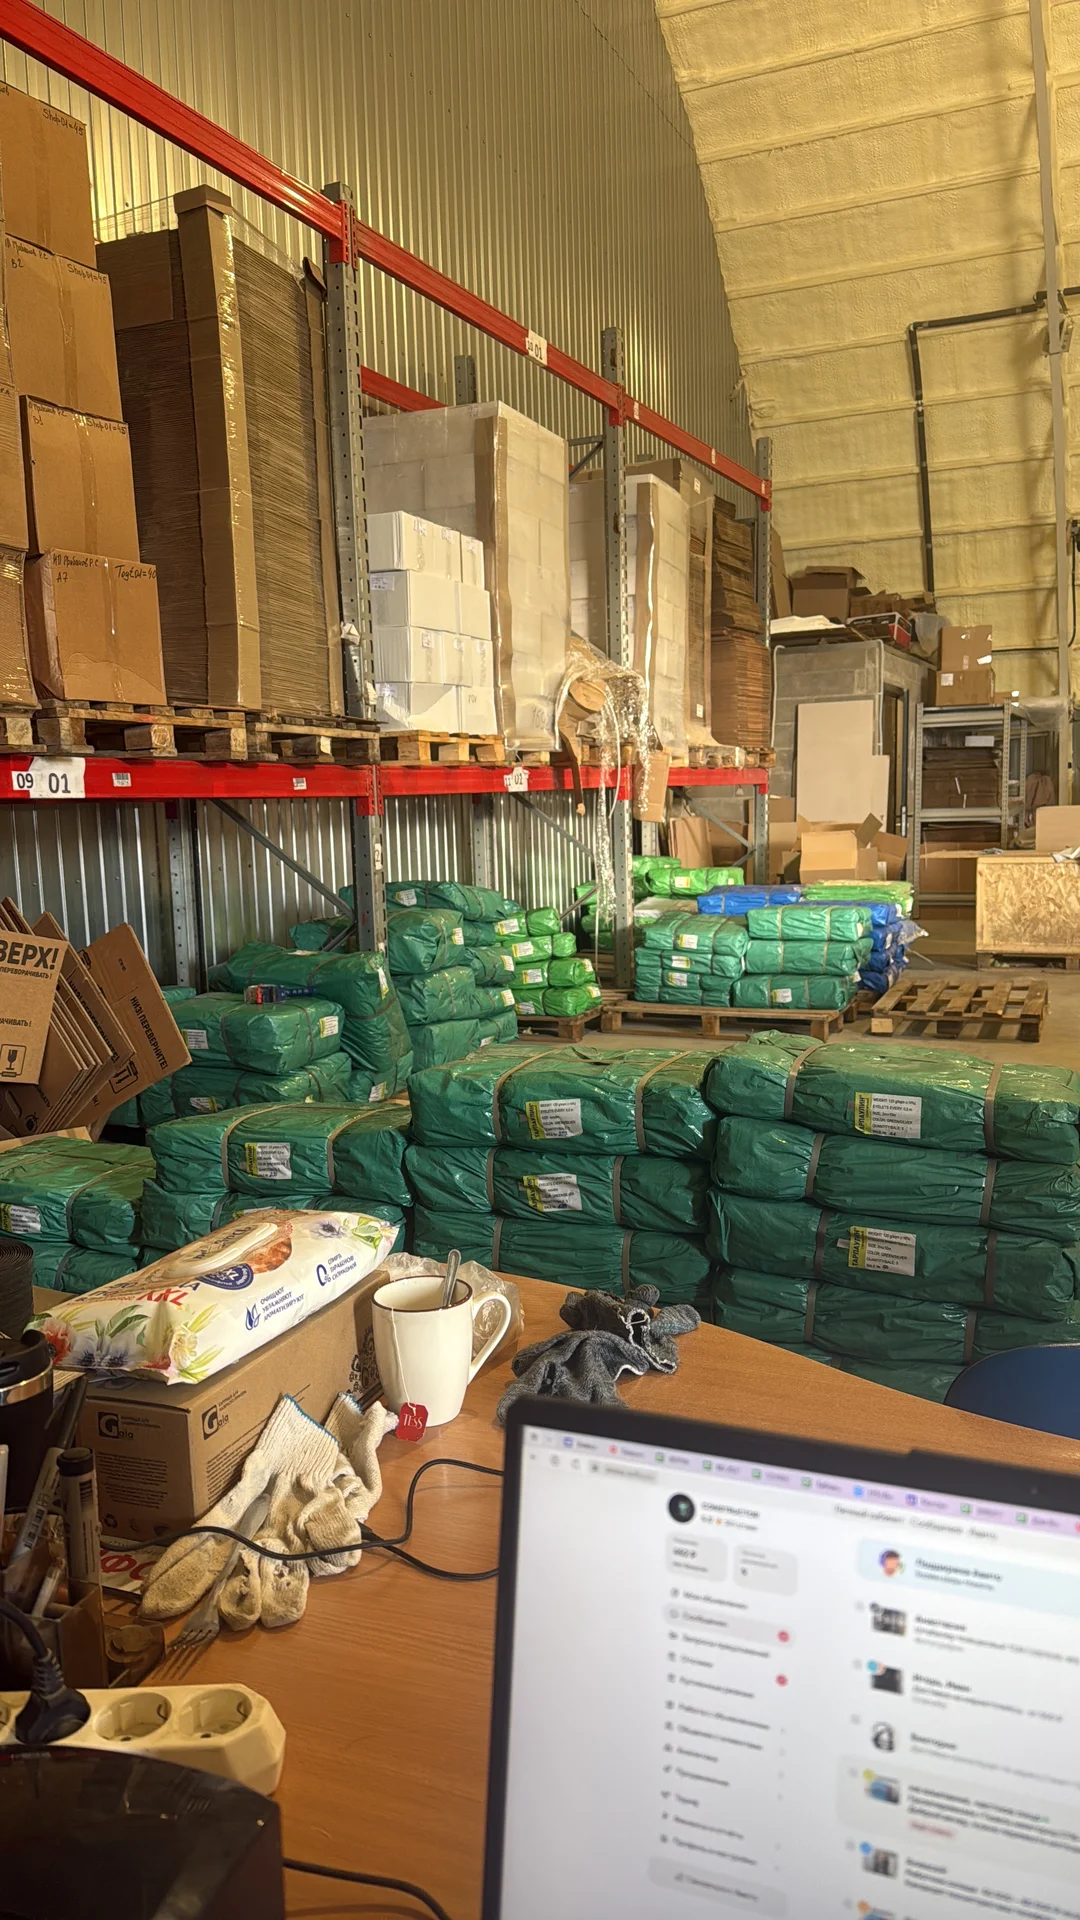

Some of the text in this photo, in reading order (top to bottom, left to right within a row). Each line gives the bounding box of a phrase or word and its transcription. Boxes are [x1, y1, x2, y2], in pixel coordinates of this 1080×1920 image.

[16, 772, 71, 794] 09 01
[138, 1013, 169, 1070] ПЕРЕВЕРНИТЕ!
[260, 1286, 285, 1305] ОЧИЩАЮТ
[262, 1291, 293, 1313] УВЛАЖНЯЮТ
[263, 1294, 305, 1322] АРОМАТИЗИРУЮТ
[403, 1413, 423, 1430] TESS
